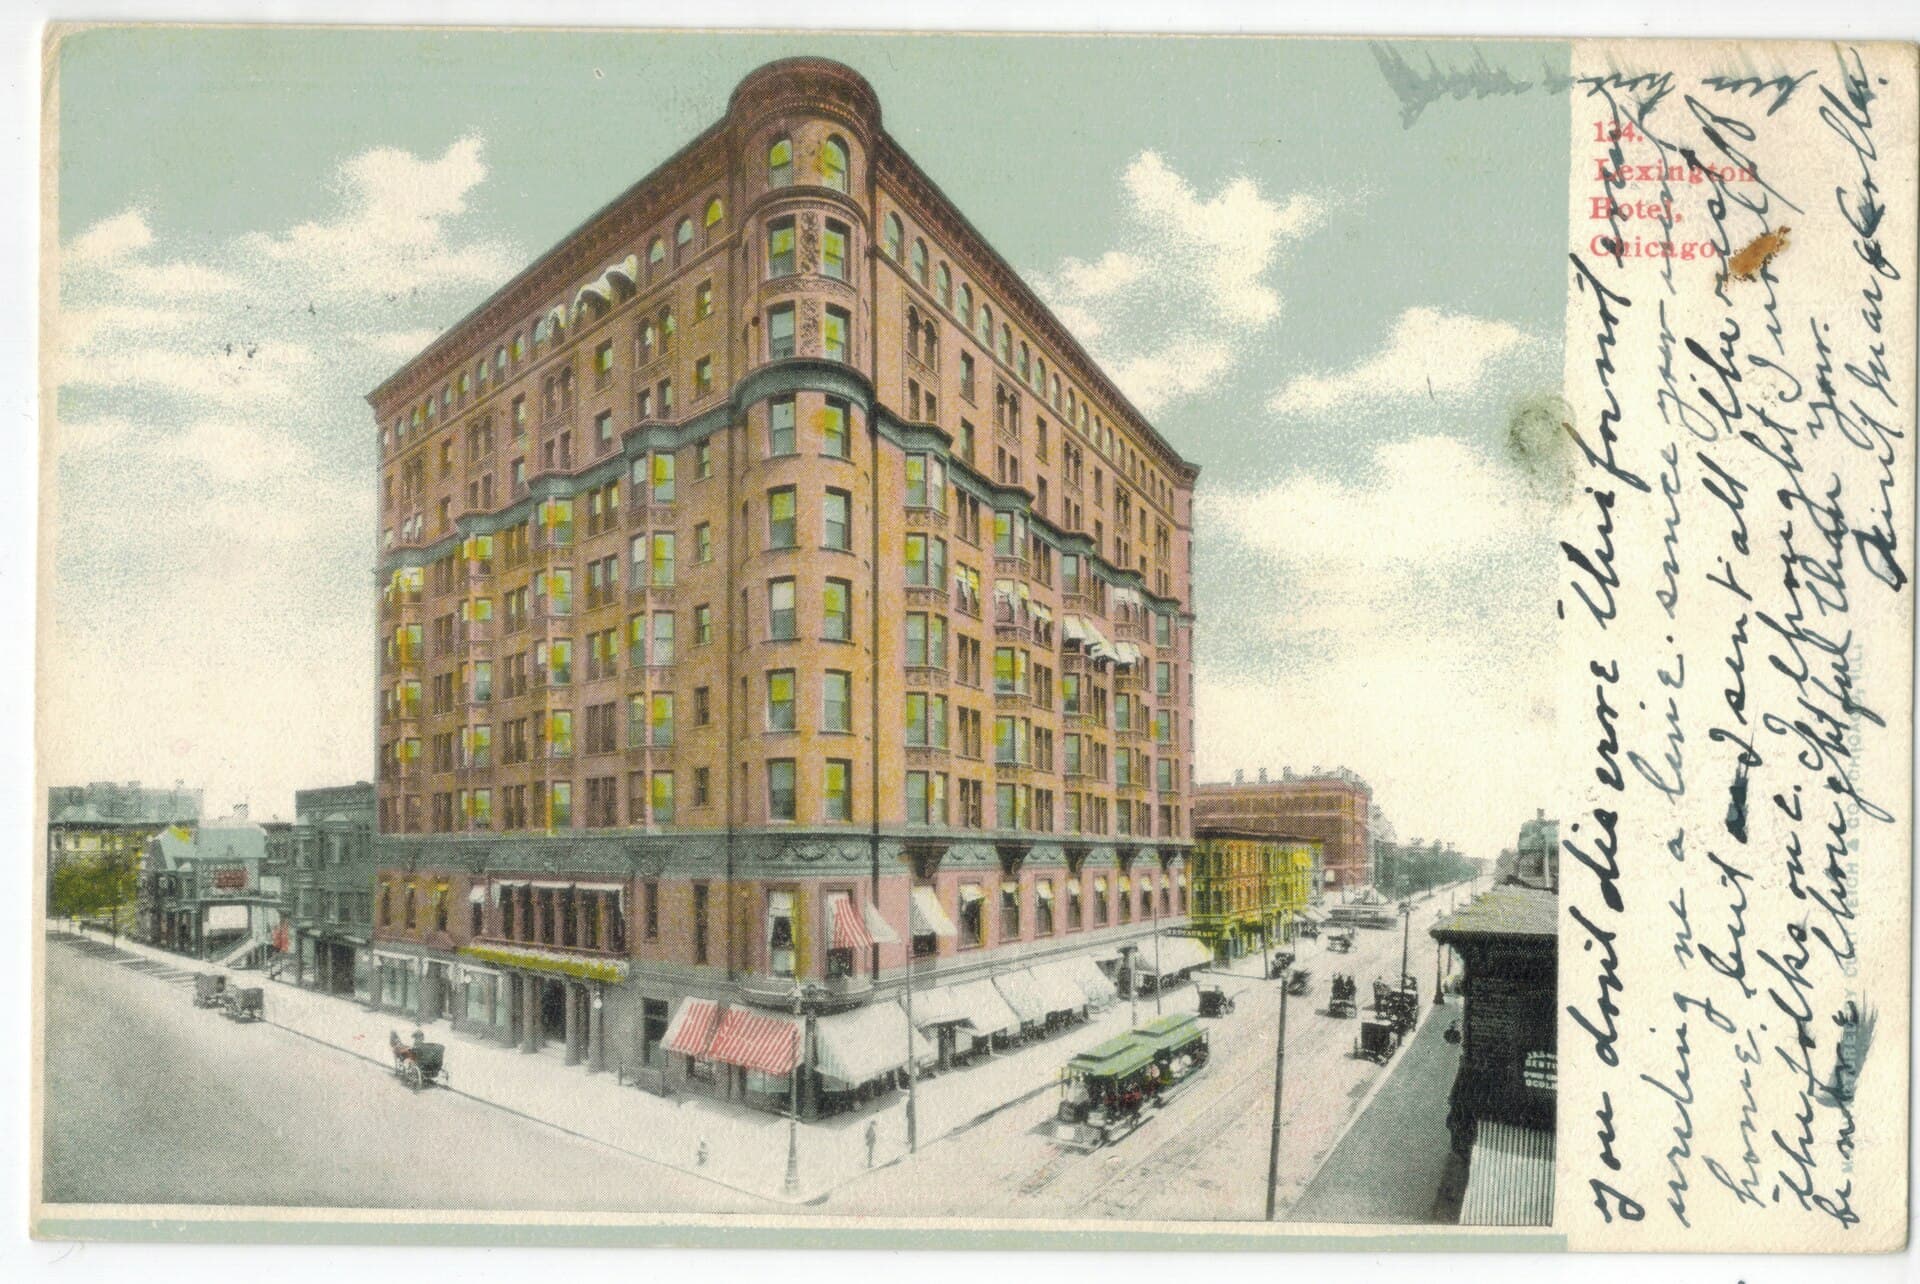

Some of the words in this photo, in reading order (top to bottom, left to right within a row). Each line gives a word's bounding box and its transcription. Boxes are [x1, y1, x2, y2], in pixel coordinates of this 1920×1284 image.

[1592, 121, 1644, 143] 134.
[1593, 158, 1758, 185] Lexington
[1588, 197, 1683, 222] Hotel,
[1569, 252, 1633, 388] not
[1684, 316, 1742, 434] the
[1561, 388, 1652, 494] for
[1556, 487, 1620, 631] this
[1697, 451, 1749, 556] all
[1741, 403, 1849, 698] thought
[1798, 471, 1849, 617] than
[1666, 826, 1686, 862] a
[1795, 628, 1897, 971] thoughtful
[1696, 852, 1758, 999] but
[1587, 1091, 1645, 1224] you
[1771, 1091, 1818, 1211] the
